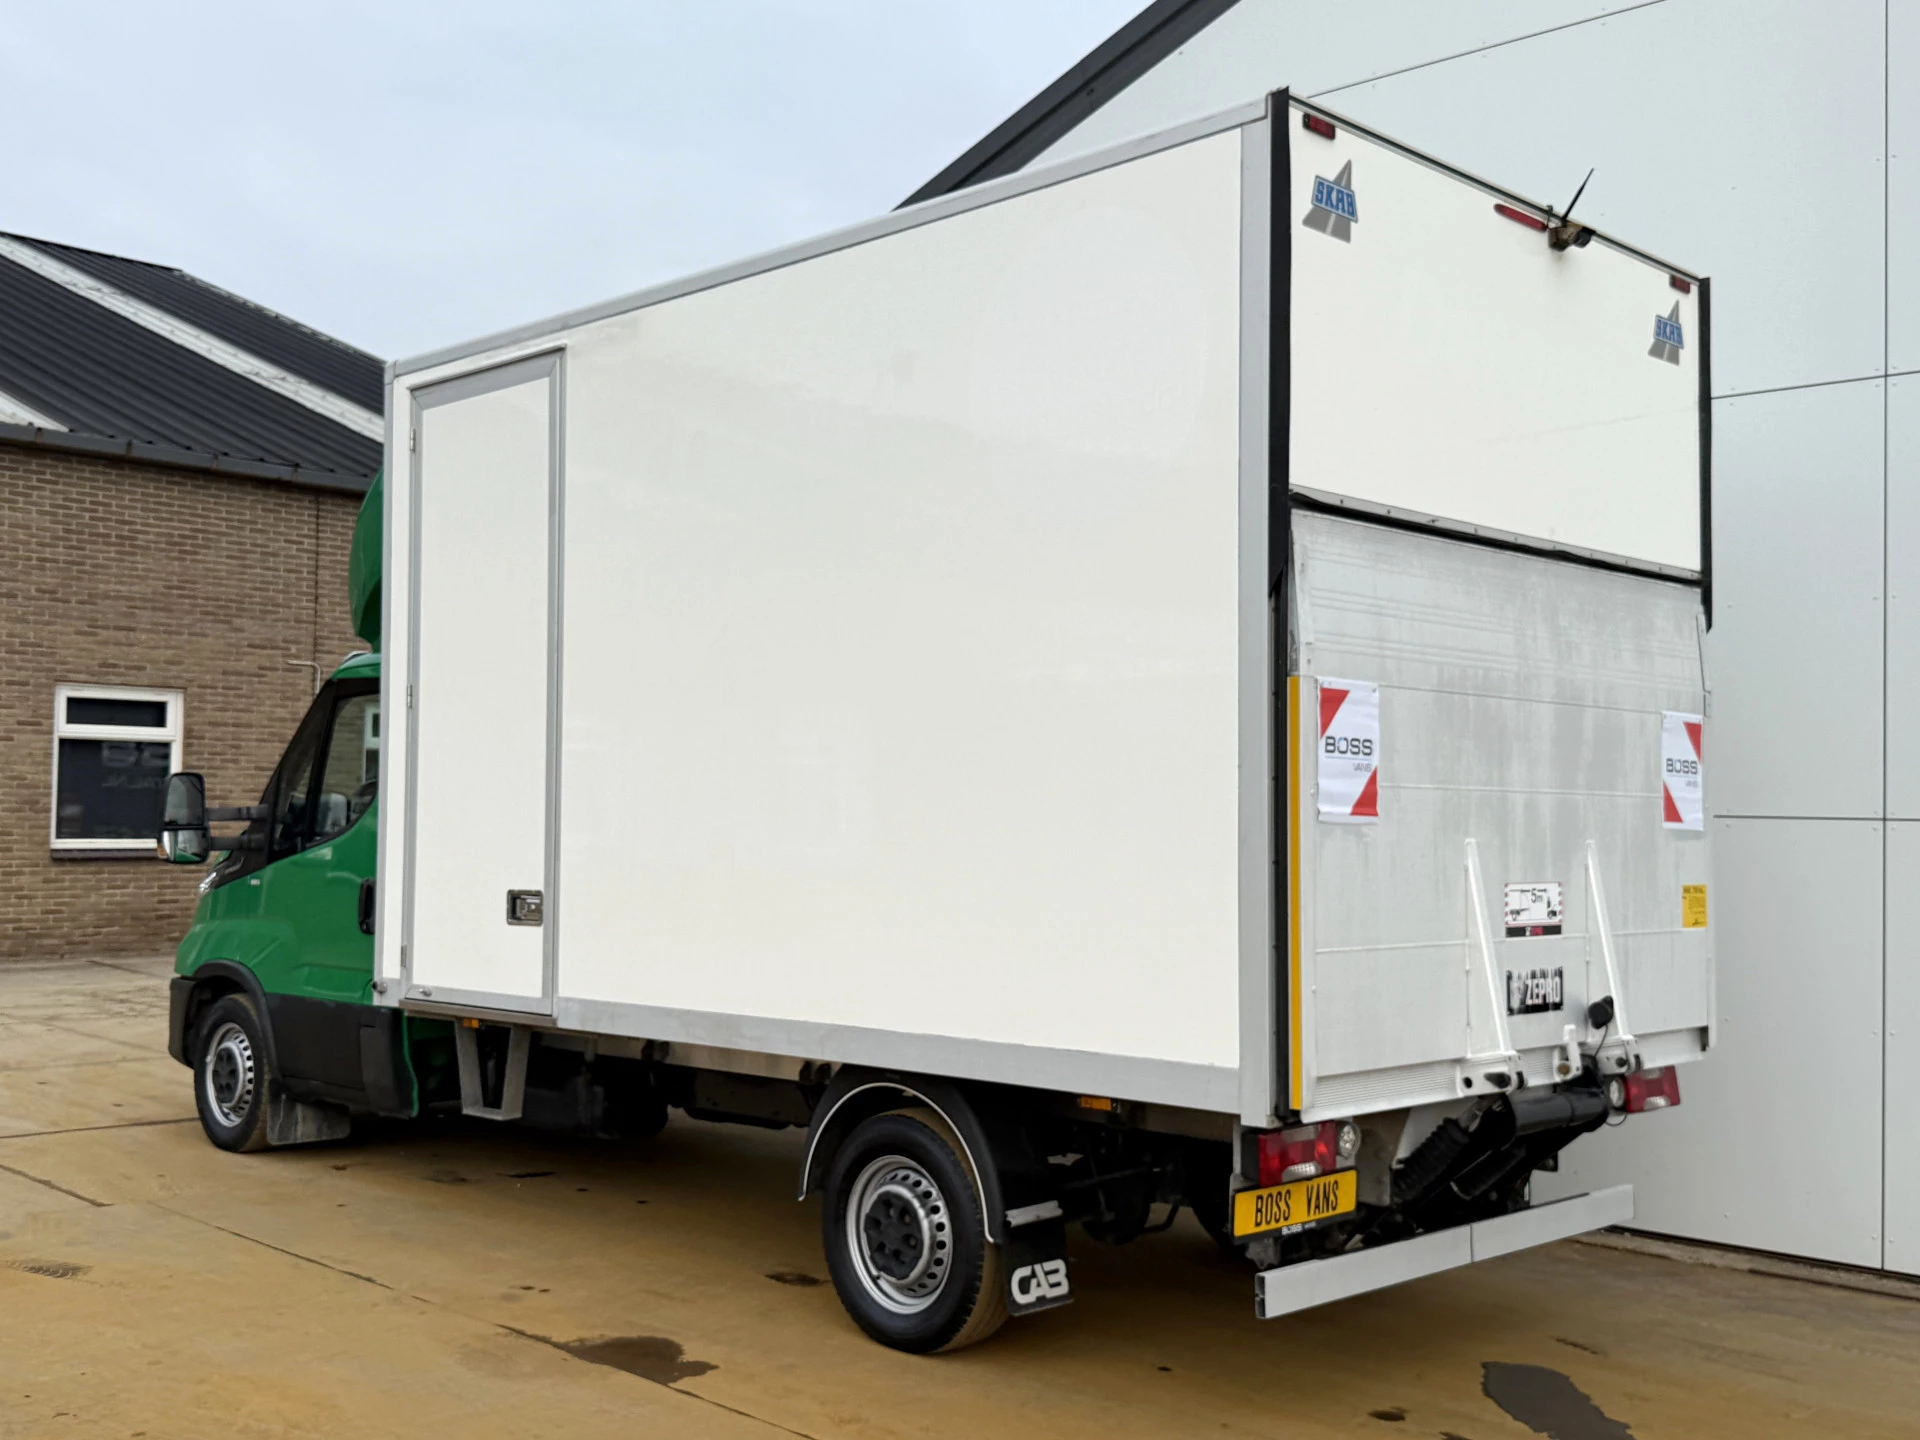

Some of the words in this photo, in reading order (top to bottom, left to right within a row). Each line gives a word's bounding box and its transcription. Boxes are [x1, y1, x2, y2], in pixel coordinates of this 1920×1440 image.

[1314, 180, 1356, 218] SKAB
[1655, 318, 1682, 347] SKAB
[1324, 736, 1373, 756] BOSS
[1665, 758, 1698, 775] BOSS
[1525, 976, 1561, 1005] ZEPRO
[1254, 1188, 1291, 1228] BOSS
[1306, 1180, 1339, 1217] VANS
[1011, 1259, 1070, 1305] CAB
